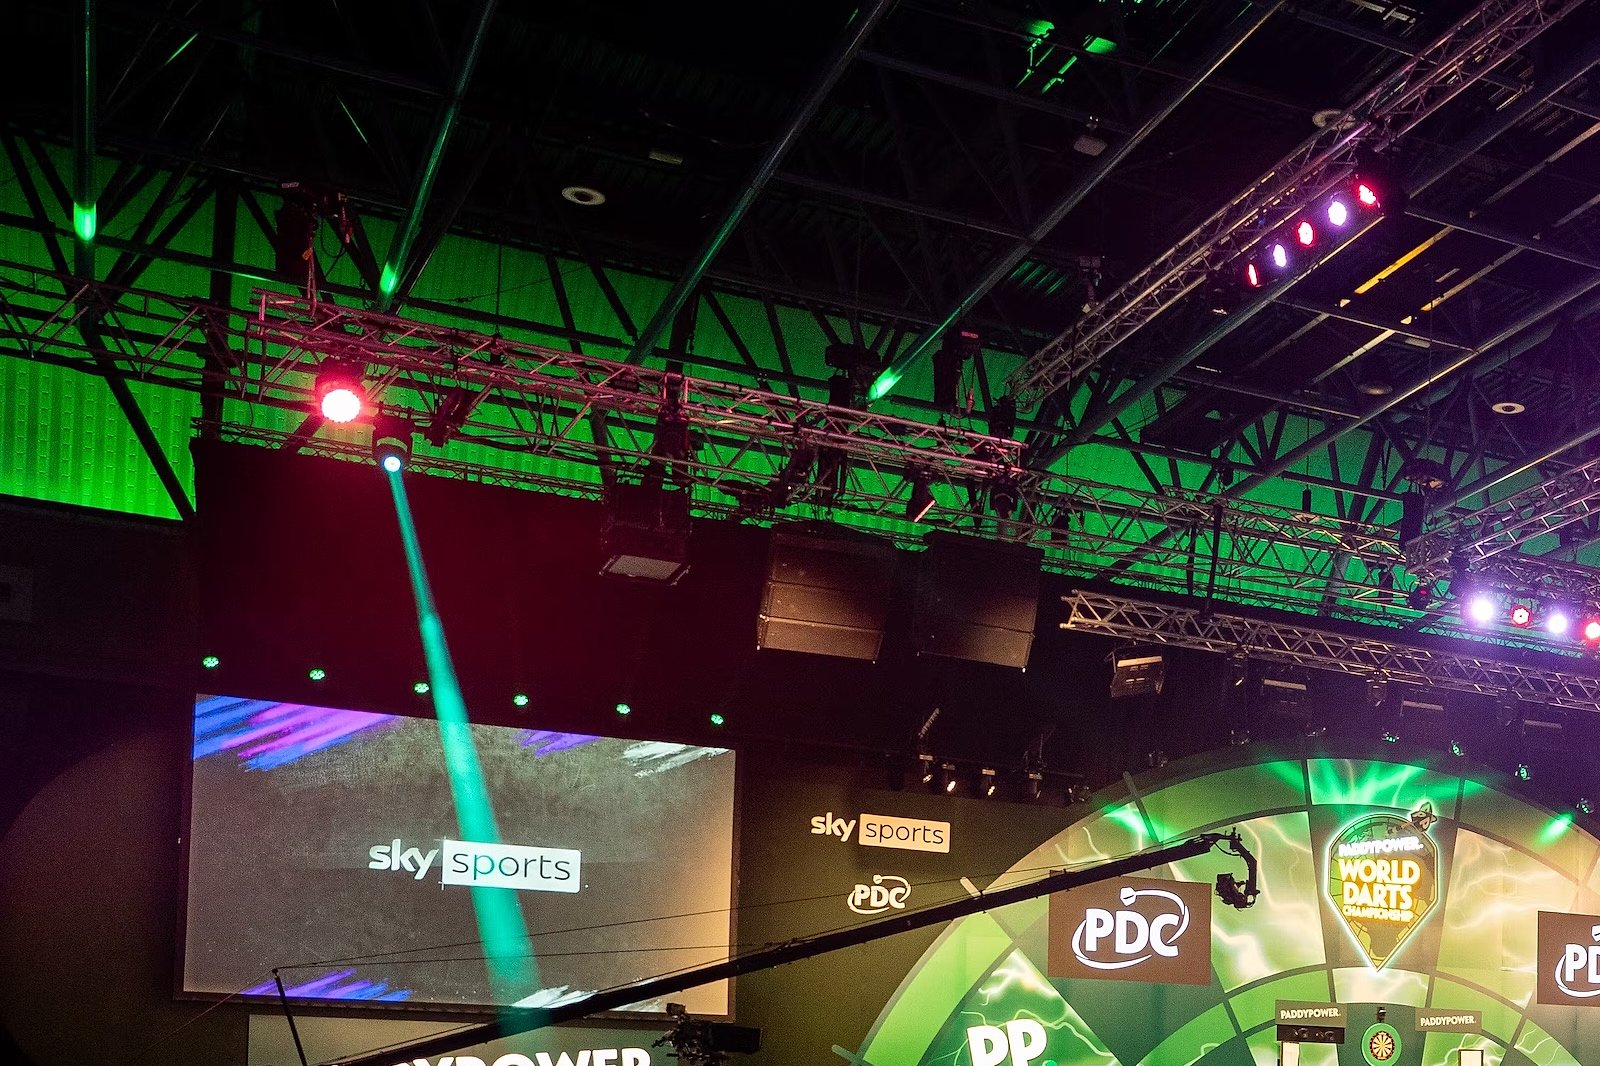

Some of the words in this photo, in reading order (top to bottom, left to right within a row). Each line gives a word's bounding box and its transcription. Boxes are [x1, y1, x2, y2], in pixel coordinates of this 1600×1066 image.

[811, 812, 857, 842] sky
[865, 823, 944, 844] sports
[368, 838, 440, 880] sky
[451, 853, 571, 881] sports
[1338, 858, 1421, 885] WORLD
[854, 884, 906, 909] PDC
[1343, 881, 1413, 910] DARTS
[1343, 905, 1414, 922] CHAMPIONSHIP
[1084, 907, 1180, 957] PDC
